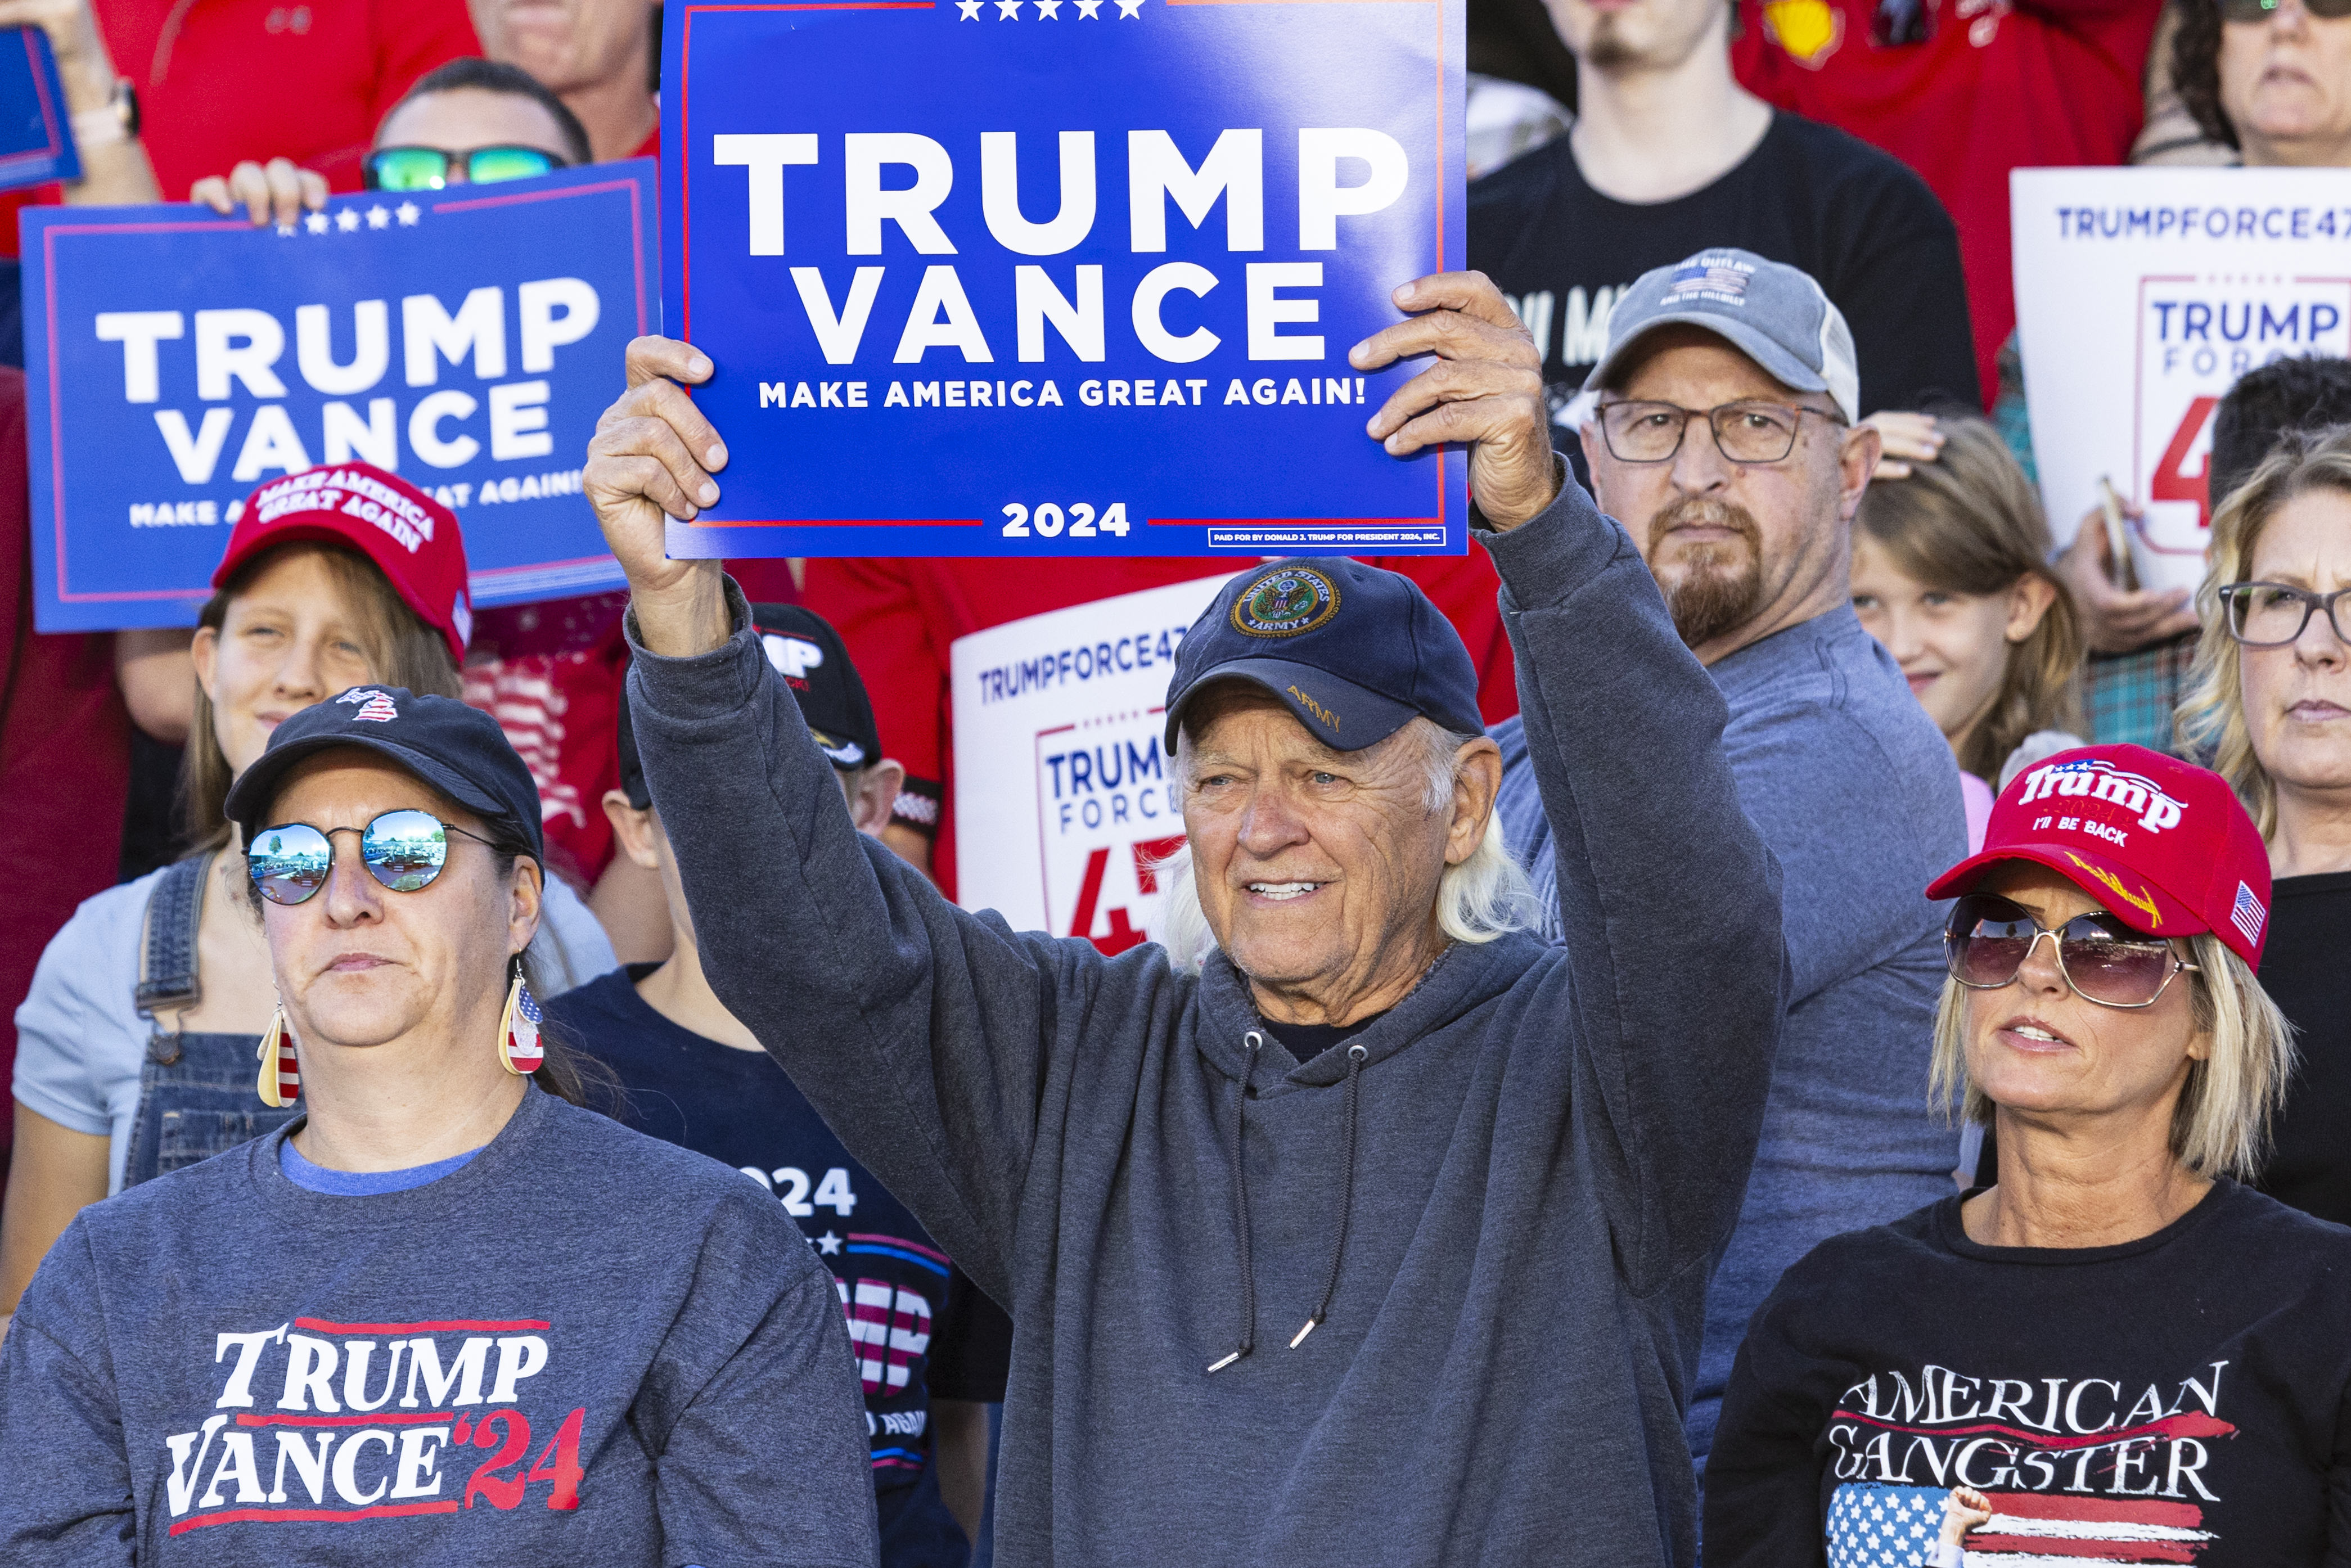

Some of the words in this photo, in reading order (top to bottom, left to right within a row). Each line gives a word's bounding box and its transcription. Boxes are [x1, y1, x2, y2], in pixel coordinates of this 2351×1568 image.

[714, 128, 1409, 256] TRUMP
[1700, 256, 1755, 273] OUTLAW
[789, 262, 1325, 364] VANCE
[1660, 294, 1680, 307] AND
[1682, 290, 1699, 301] THE
[1700, 290, 1745, 307] HILLBILLY
[2152, 301, 2340, 343] TRUMP
[96, 277, 601, 404] TRUMP
[2163, 347, 2287, 376] FOR
[759, 381, 868, 408] MAKE
[884, 380, 1064, 408] AMERICA
[1079, 379, 1208, 407] GREAT
[1223, 377, 1365, 405] AGAIN!
[154, 380, 553, 485] VANCE
[129, 499, 218, 528] MAKE
[255, 471, 329, 510] MAKE
[325, 469, 435, 543] AMERICA
[258, 490, 343, 524] GREAT
[340, 494, 425, 553] AGAIN
[1002, 502, 1131, 538] 2024
[1400, 532, 1422, 541] 2024,
[1423, 532, 1440, 540] INC.
[1243, 570, 1292, 603] UNITED
[1294, 570, 1330, 603] STATES
[1253, 619, 1299, 630] ARMY
[1287, 684, 1341, 733] ARMY
[1046, 735, 1163, 799] TRUM
[2018, 763, 2182, 834] Trump
[2057, 816, 2080, 830] BE
[2083, 819, 2129, 848] BACK
[215, 1322, 549, 1413] TRUMP
[1837, 1359, 2230, 1434] AMERICAN
[165, 1414, 451, 1517] VANCE
[453, 1407, 586, 1510] '24
[1828, 1425, 2221, 1502] GANGSTER
